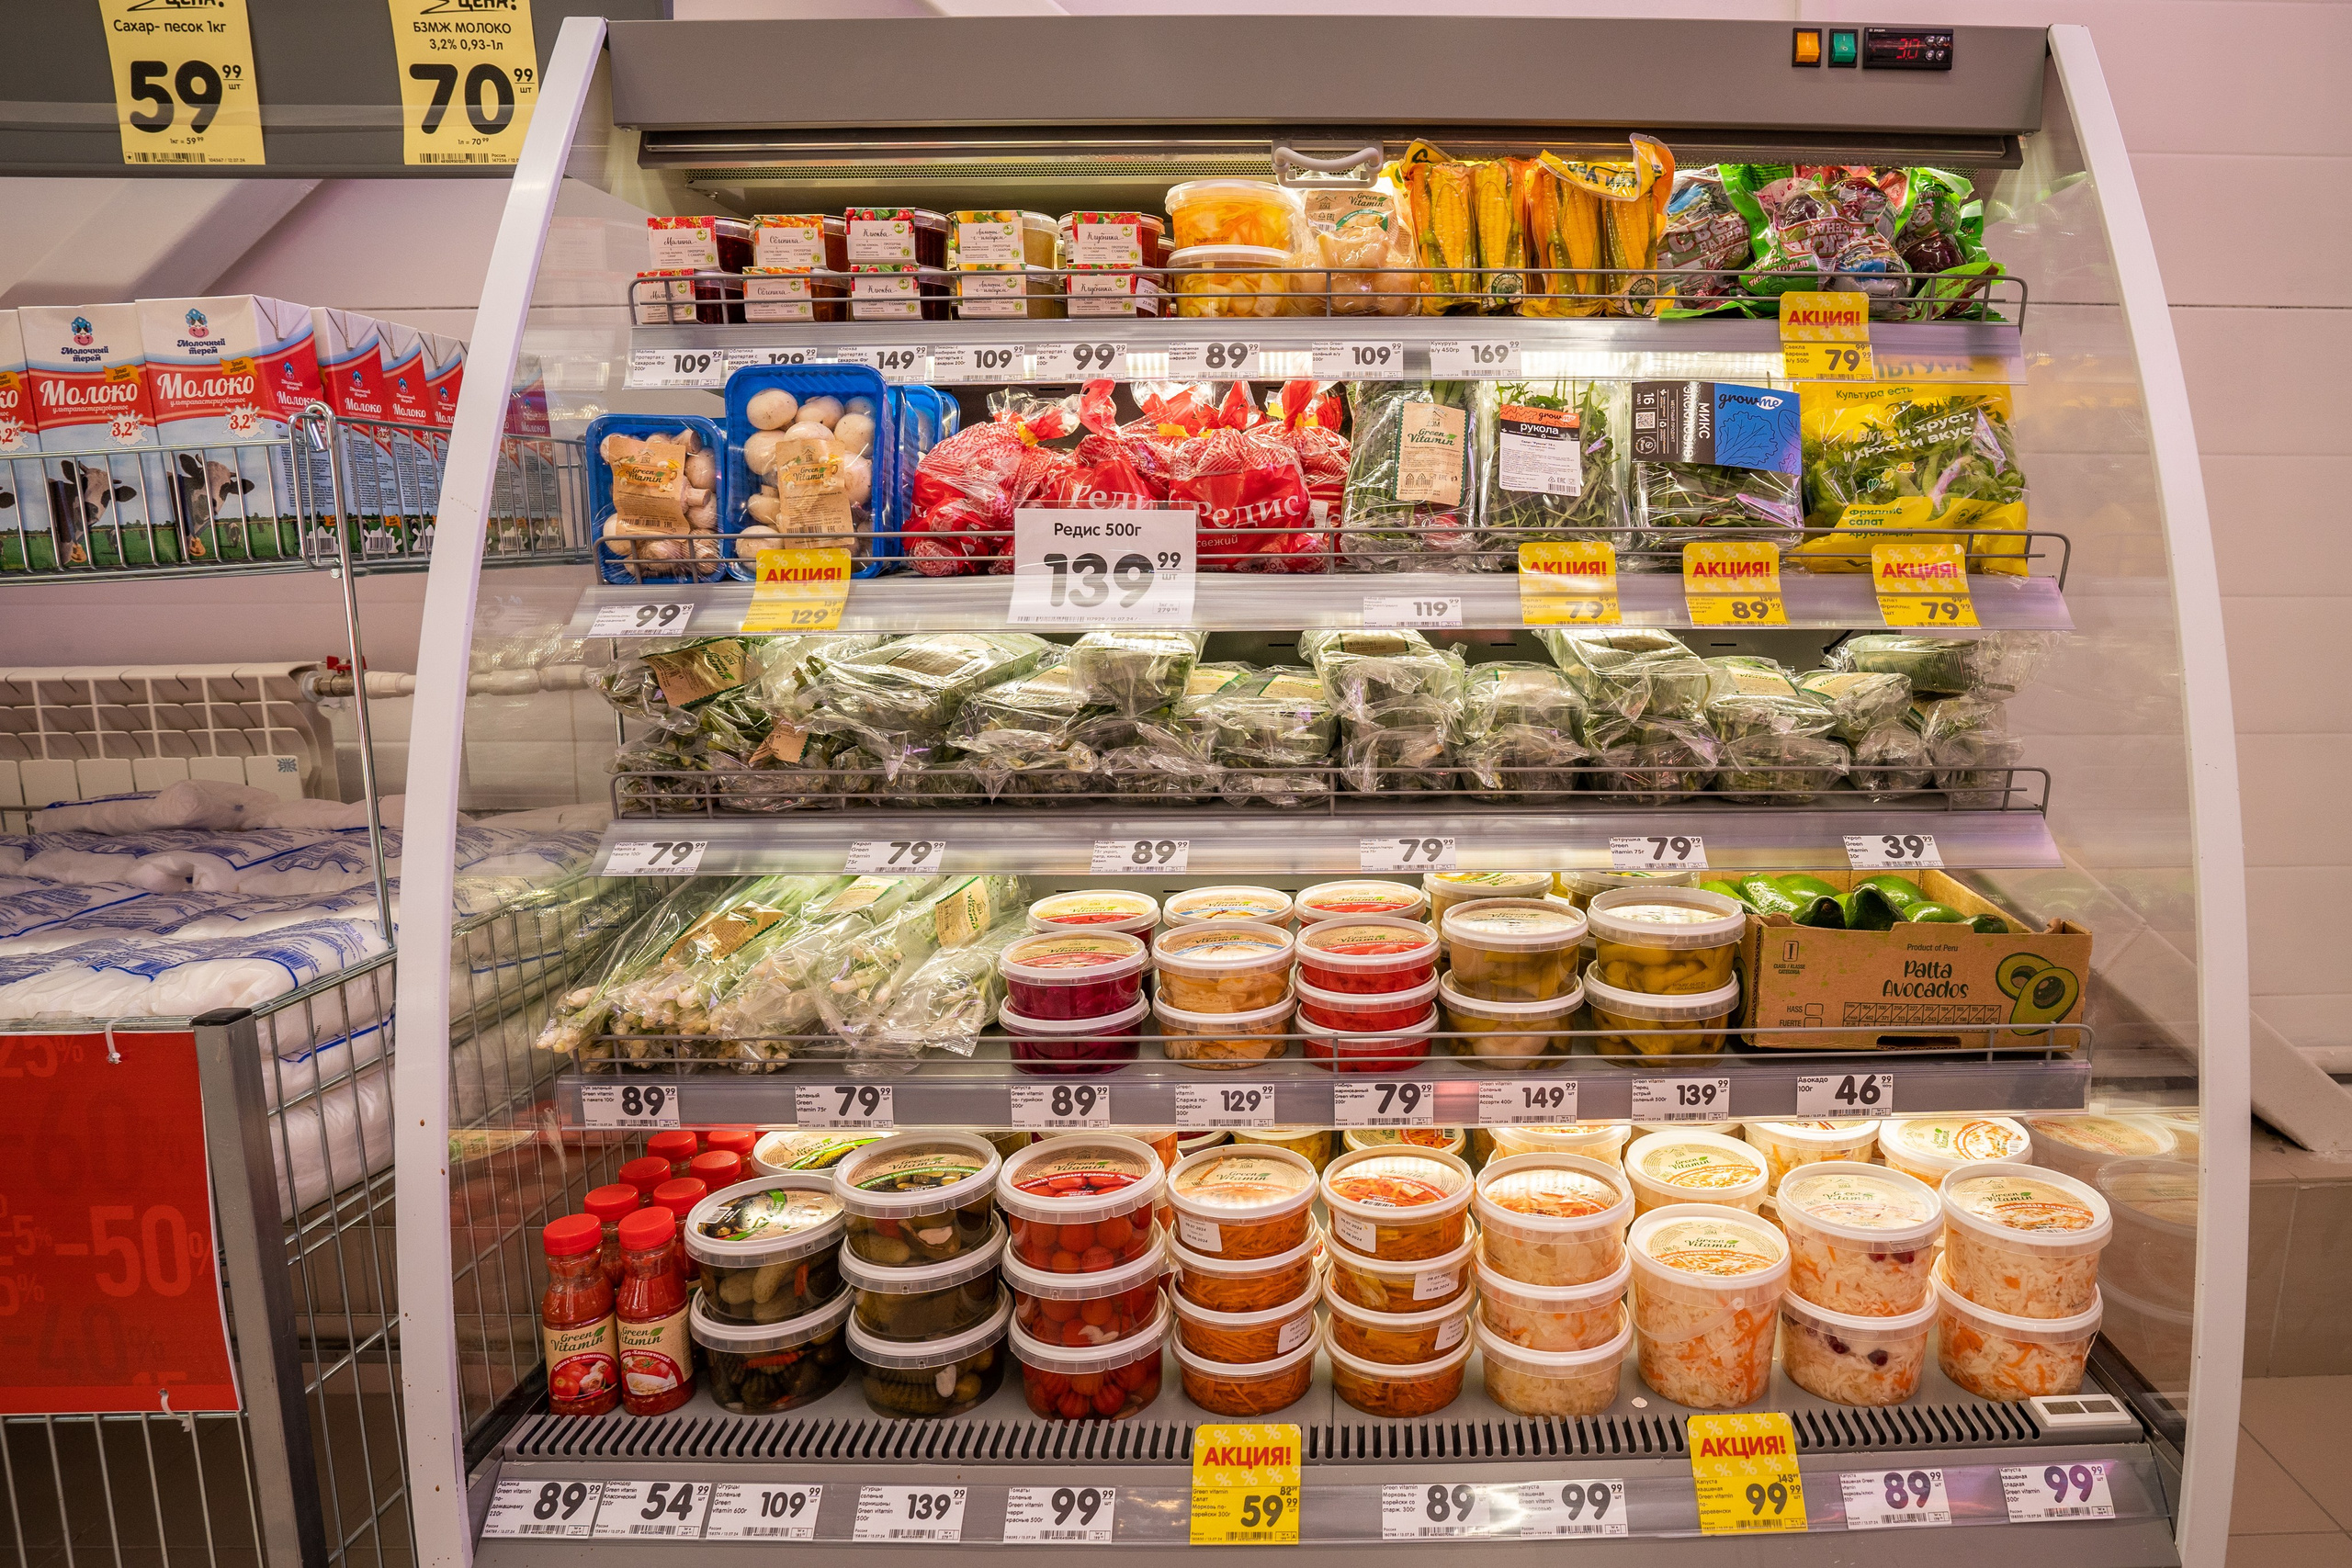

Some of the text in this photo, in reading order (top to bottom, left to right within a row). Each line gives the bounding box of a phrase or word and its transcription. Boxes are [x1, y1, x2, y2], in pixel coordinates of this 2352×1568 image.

[113, 19, 227, 35] Сахар- песок 1кг
[413, 22, 512, 34] БЗМЖ МОЛОКО
[429, 39, 503, 51] 3,2% 0,93-1л
[222, 64, 242, 78] 99
[514, 68, 533, 82] 99
[130, 60, 222, 134] 59
[409, 63, 514, 135] 70
[1348, 197, 1385, 208] Vitamin
[1357, 192, 1378, 201] Green
[1787, 310, 1861, 328] АКЦИЯ!
[61, 346, 108, 355] Молочный
[176, 339, 226, 348] Молочный
[188, 346, 219, 355] терем
[73, 355, 102, 363] терем
[673, 354, 710, 373] 109
[876, 351, 914, 369] 149
[974, 350, 1012, 368] 109
[1072, 344, 1115, 370] 99
[1205, 343, 1249, 368] 89
[1351, 346, 1390, 365] 109
[1471, 345, 1509, 364] 169
[1825, 349, 1860, 371] 79
[40, 379, 138, 406] Молоко
[156, 372, 254, 400] Молоко
[1836, 386, 1914, 400] Культура есть
[170, 396, 246, 408] ультрапастеризованное
[277, 390, 316, 406] Молоко
[345, 398, 382, 413] Молоко
[1643, 392, 1654, 404] 16
[1719, 392, 1783, 409] growme
[52, 404, 129, 415] ультрапастеризованное
[392, 403, 426, 418] Молоко
[112, 422, 139, 437] 3,2%
[230, 414, 256, 431] 3,2%
[1520, 423, 1559, 436] рукола
[1700, 402, 1710, 440] МИКС
[1858, 428, 1894, 443] вкус
[1898, 428, 1911, 438] и
[1915, 412, 1975, 433] хруст,
[1408, 433, 1455, 446] Vitamin
[1419, 427, 1445, 438] Green
[1854, 443, 1905, 461] хруст
[1911, 438, 1924, 447] и
[626, 472, 663, 483] Vitamin
[632, 466, 655, 475] Green
[1196, 494, 1301, 530] Редис
[1849, 507, 1903, 516] Фриллис
[1054, 522, 1142, 539] Редис 500г
[1849, 517, 1884, 526] салат
[1157, 552, 1182, 568] 99
[764, 568, 842, 586] АКЦИЯ!
[1161, 572, 1178, 581] шт
[1529, 561, 1607, 578] АКЦИЯ!
[1692, 562, 1770, 580] АКЦИЯ!
[1882, 563, 1958, 580] АКЦИЯ!
[1043, 553, 1155, 608] 139
[636, 604, 681, 627] 99
[791, 609, 829, 625] 129
[1413, 602, 1449, 617] 119
[1565, 602, 1604, 619] 79
[1732, 601, 1769, 619] 89
[1921, 602, 1960, 621] 79
[648, 841, 694, 865] 79
[889, 841, 932, 865] 79
[1131, 840, 1177, 864] 89
[1398, 839, 1443, 862] 79
[1647, 837, 1691, 861] 79
[1882, 835, 1925, 859] 39
[1906, 943, 1959, 953] Product of Peru
[1904, 960, 1953, 979] Palta
[1883, 979, 1969, 999] Avocados
[1786, 1005, 1804, 1013] HASS
[1779, 1019, 1802, 1028] FUERTE
[1882, 1076, 1893, 1084] 99
[1522, 1087, 1565, 1109] 149
[1676, 1084, 1717, 1106] 139
[1835, 1074, 1881, 1105] 46
[621, 1086, 665, 1117] 89
[834, 1086, 880, 1117] 79
[1051, 1086, 1097, 1117] 89
[1220, 1090, 1261, 1111] 129
[1374, 1084, 1421, 1114] 79
[860, 1169, 929, 1190] Огурцы соленые
[1019, 1175, 1048, 1190] Томаты
[1049, 1172, 1081, 1181] соленые
[1216, 1173, 1268, 1182] Vitamin
[1685, 1239, 1738, 1249] Vitamin
[561, 1331, 593, 1342] Green
[622, 1326, 650, 1336] Green
[551, 1336, 605, 1352] Vitamin
[1700, 1436, 1787, 1459] АКЦИЯ!
[1203, 1447, 1292, 1470] АКЦИЯ!
[2091, 1466, 2103, 1475] 99
[587, 1484, 601, 1495] 99
[1883, 1471, 1931, 1509] 89
[2044, 1464, 2094, 1504] 99
[533, 1483, 587, 1520] 89
[640, 1483, 694, 1520] 54
[762, 1492, 806, 1517] 109
[908, 1494, 951, 1519] 139
[1051, 1488, 1101, 1526] 99
[1426, 1484, 1475, 1522] 89
[1562, 1483, 1611, 1521] 99
[1746, 1483, 1788, 1516] 99
[1240, 1495, 1283, 1528] 59
